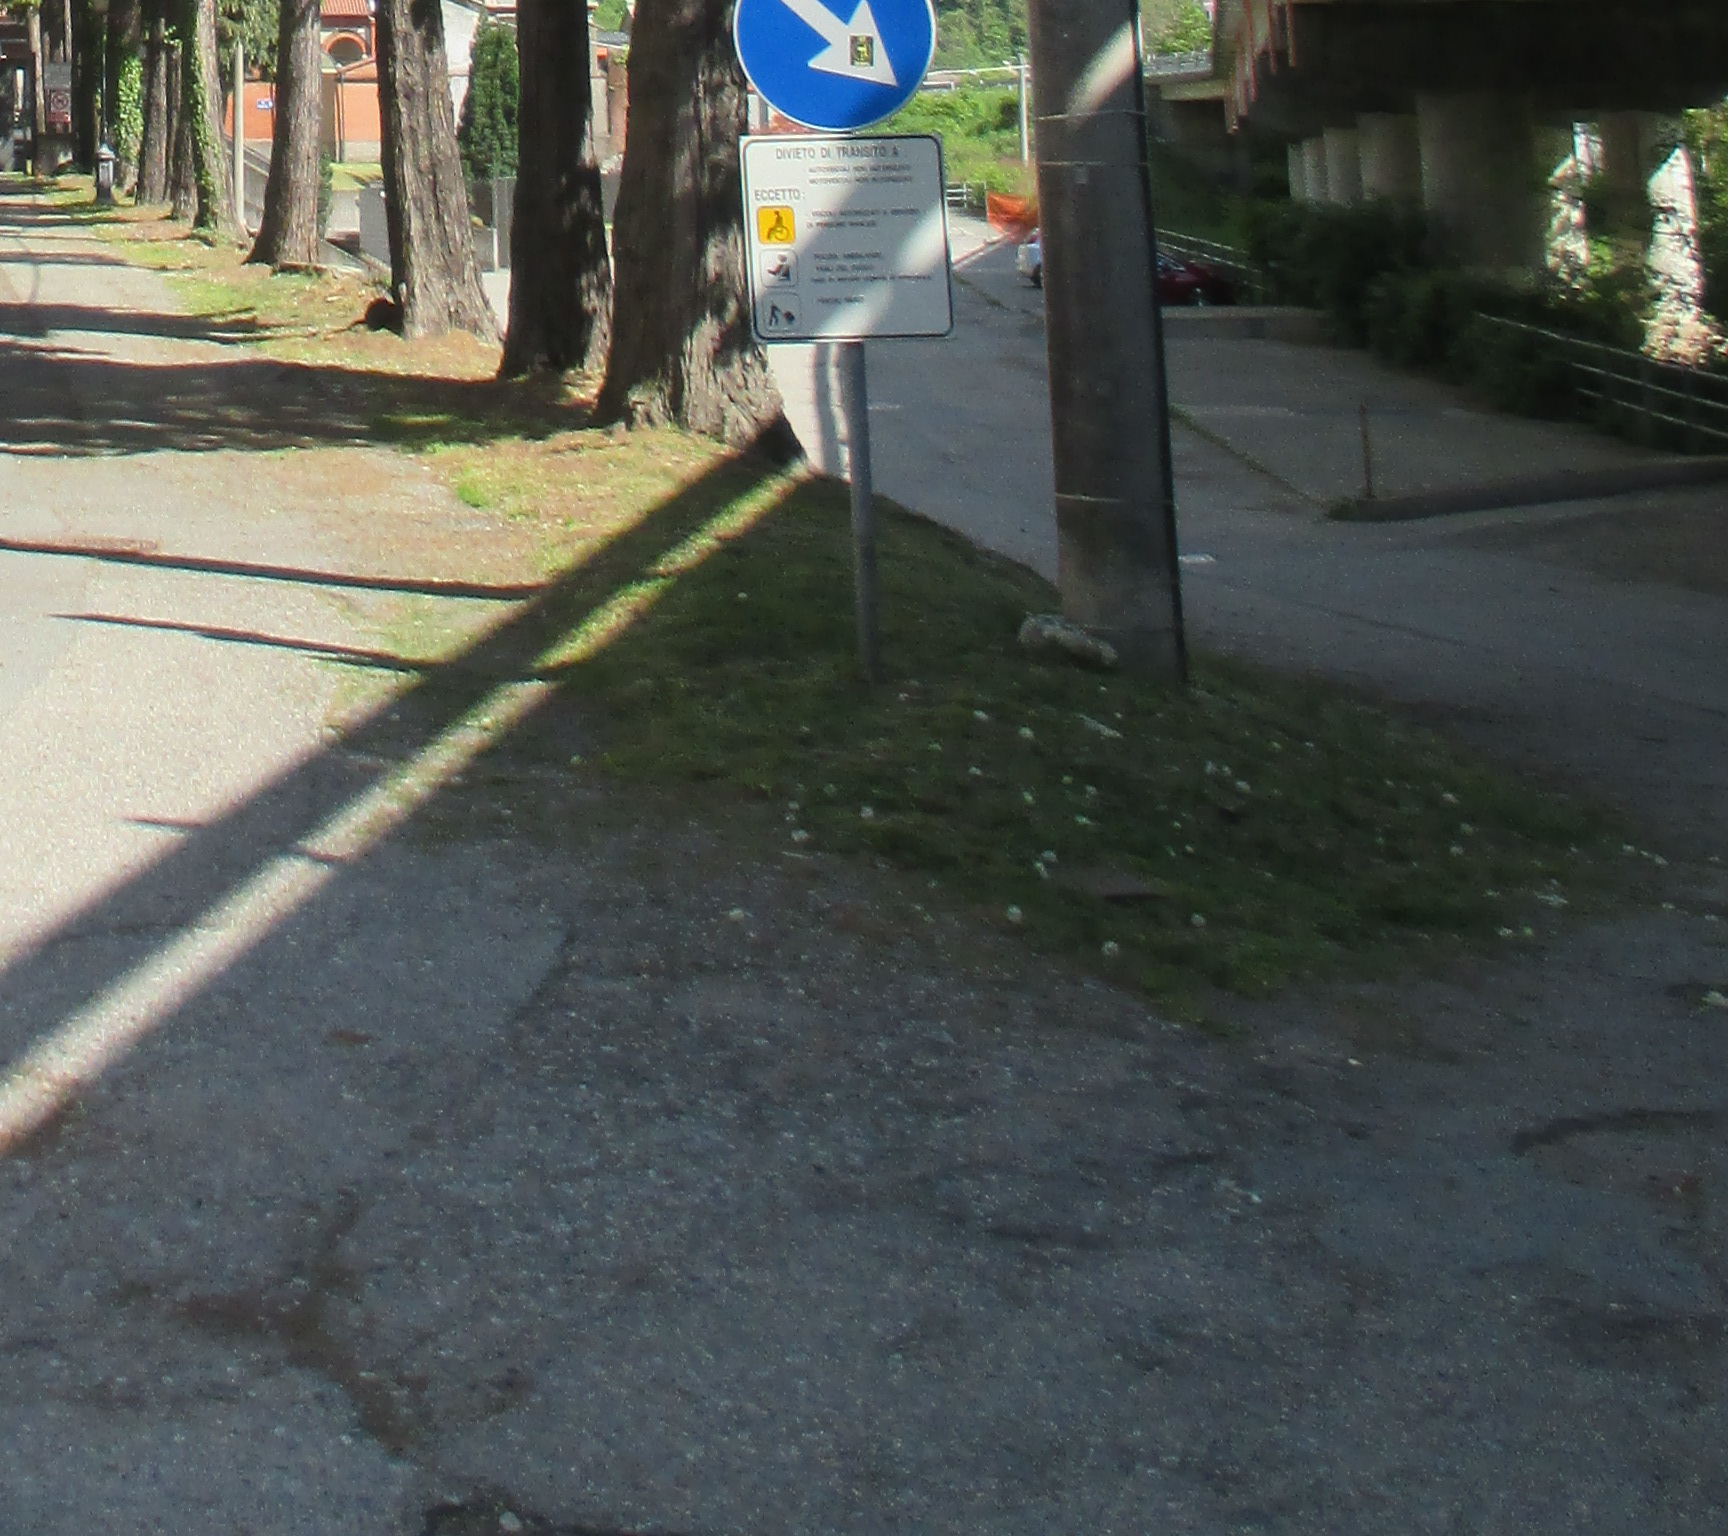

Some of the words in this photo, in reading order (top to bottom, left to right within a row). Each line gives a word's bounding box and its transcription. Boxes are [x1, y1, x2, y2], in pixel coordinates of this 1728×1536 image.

[776, 147, 815, 159] DIVIETO
[821, 146, 832, 159] DI
[835, 145, 887, 158] TRANSITO
